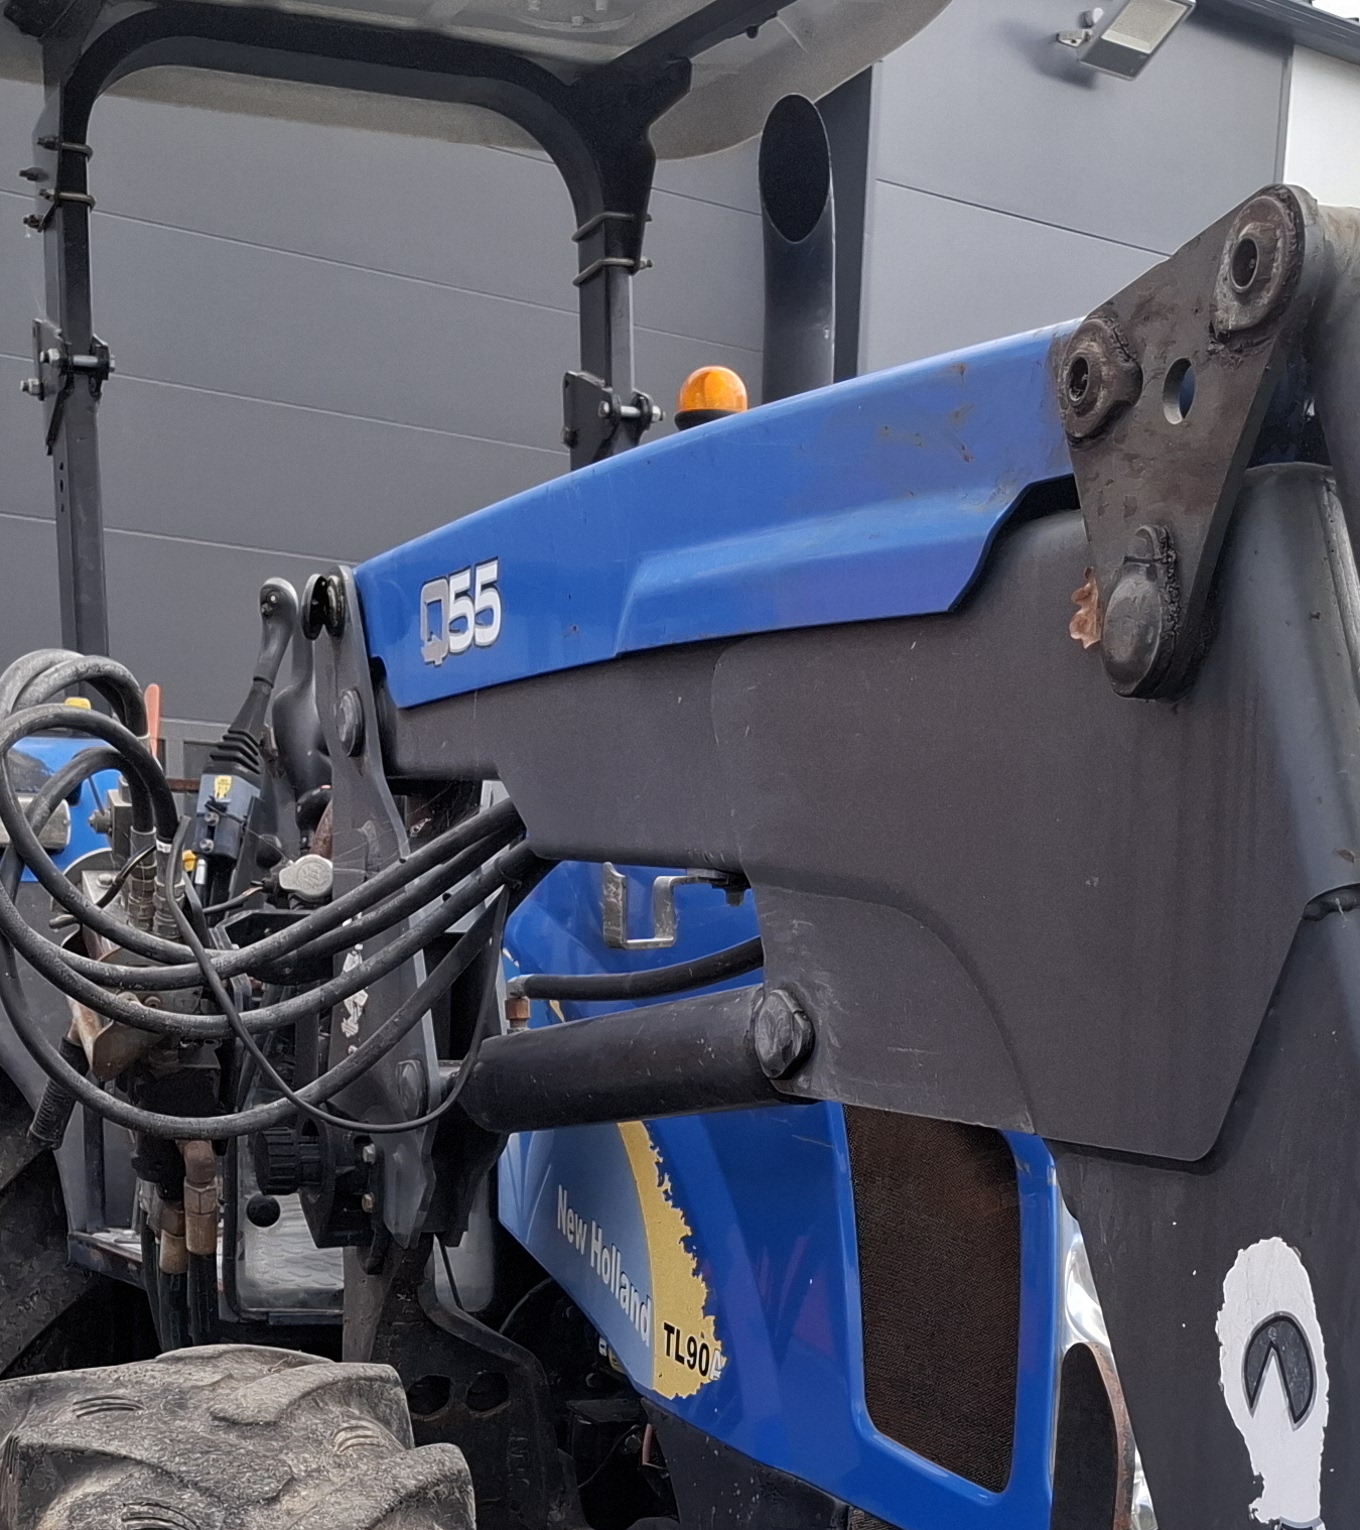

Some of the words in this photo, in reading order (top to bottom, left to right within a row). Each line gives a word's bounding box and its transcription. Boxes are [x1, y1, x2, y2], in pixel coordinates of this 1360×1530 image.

[420, 557, 502, 667] Q55
[557, 1185, 587, 1254] New
[590, 1219, 652, 1347] Holland
